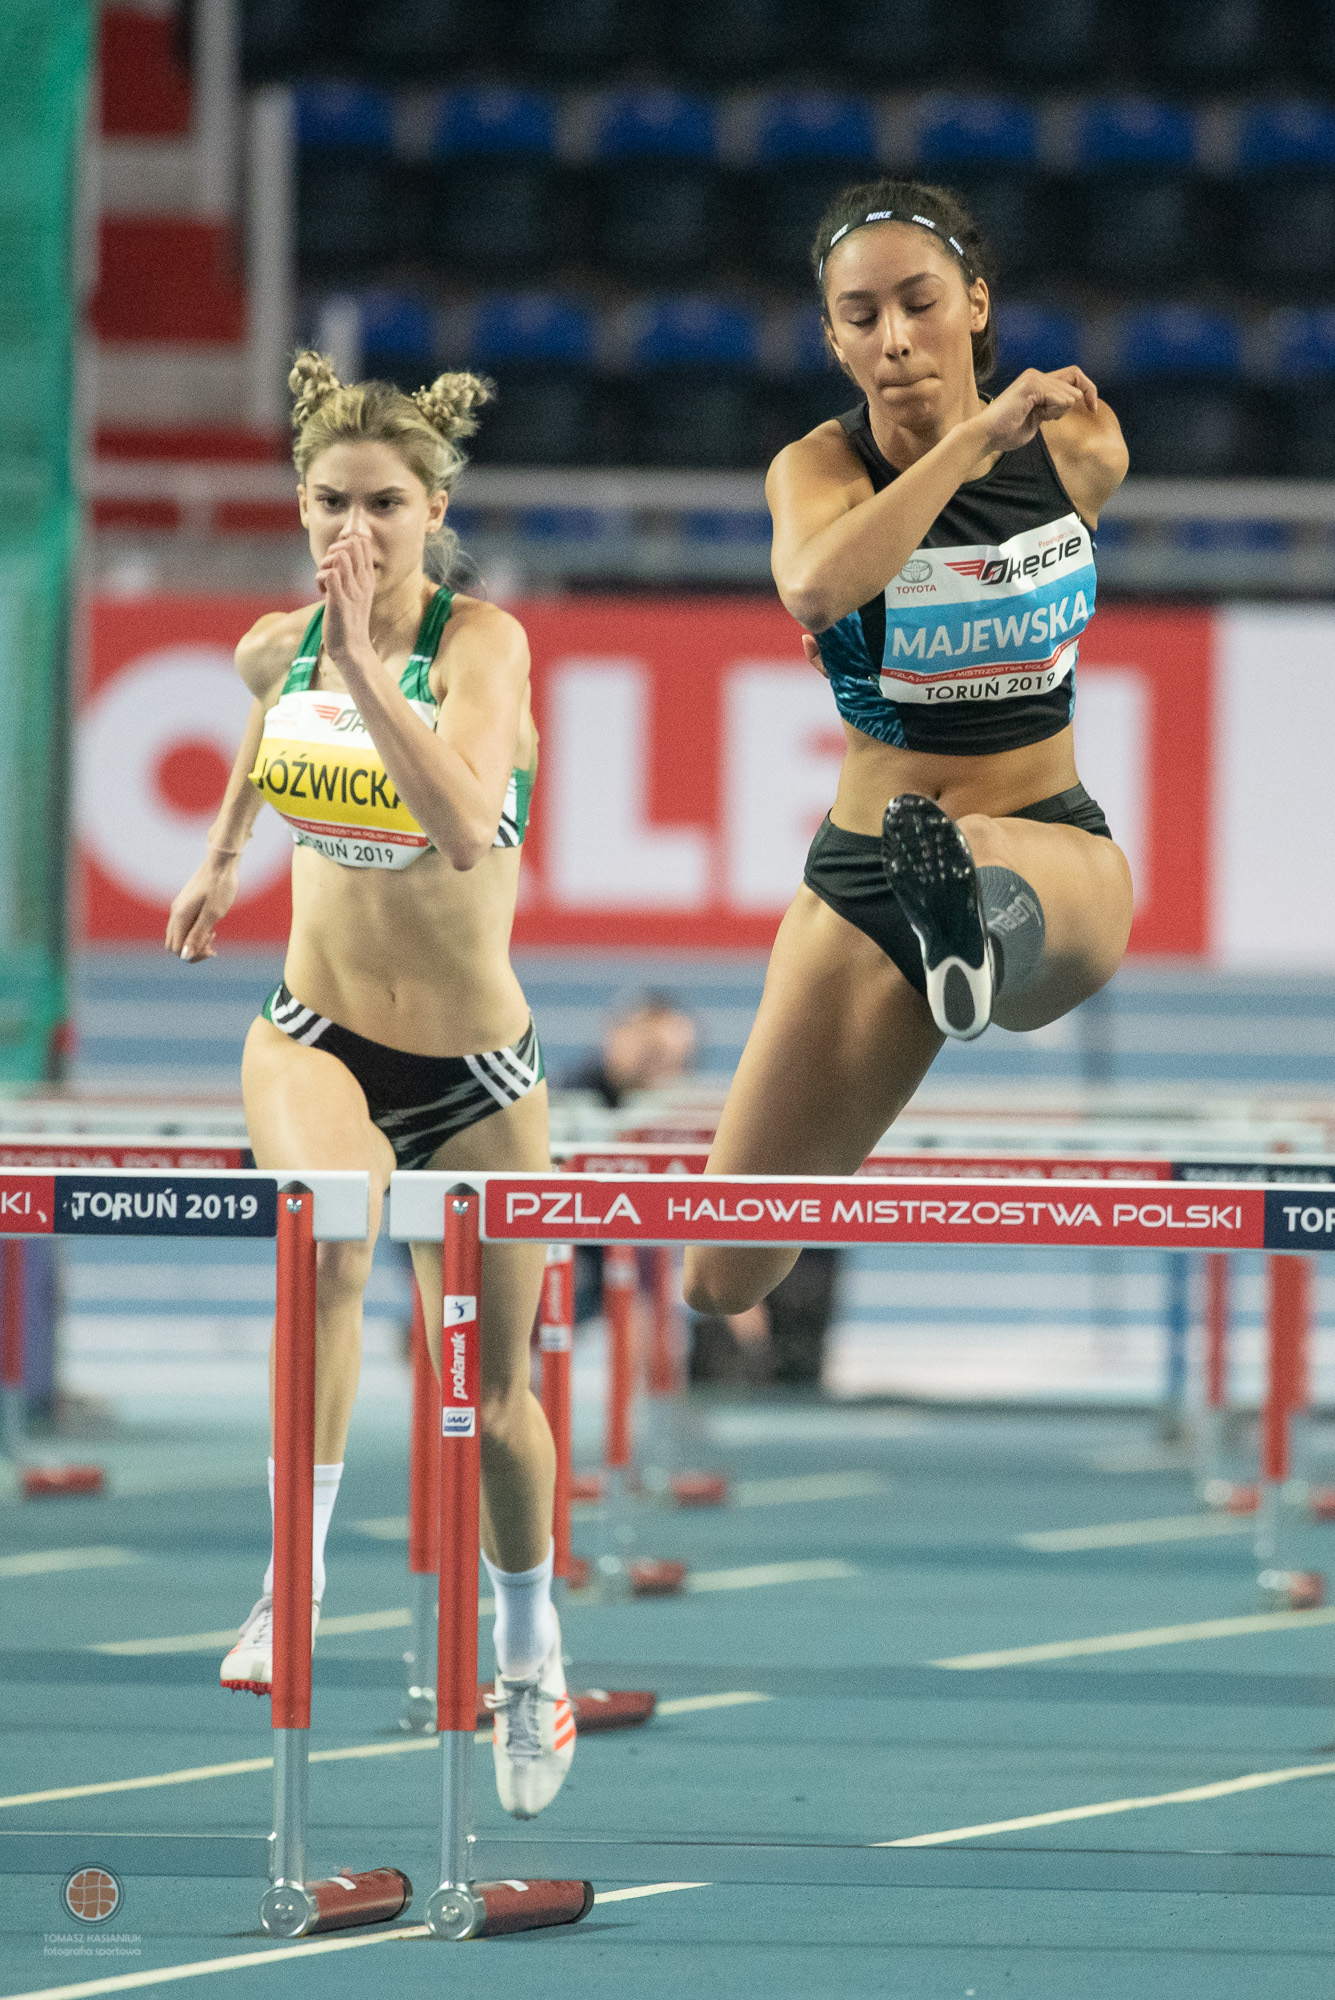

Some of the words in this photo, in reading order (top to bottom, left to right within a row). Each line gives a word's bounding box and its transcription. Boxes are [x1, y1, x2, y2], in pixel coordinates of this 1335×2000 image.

[865, 210, 893, 222] NIKE
[911, 214, 936, 229] NIKE
[948, 236, 965, 256] NIKE
[896, 584, 937, 595] TOYOTA
[892, 589, 1089, 660] MAJEWSKA
[925, 677, 1000, 700] TORUŃ
[1006, 672, 1056, 694] 2019
[353, 845, 394, 864] 2019
[72, 1188, 178, 1221] TORUŃ
[184, 1194, 259, 1220] 2019
[506, 1192, 642, 1225] PZLA
[667, 1198, 821, 1222] HALOWE
[831, 1200, 1103, 1227] MISTRZOSTWA
[1112, 1205, 1242, 1230] POLSKI
[450, 1331, 469, 1400] polanik
